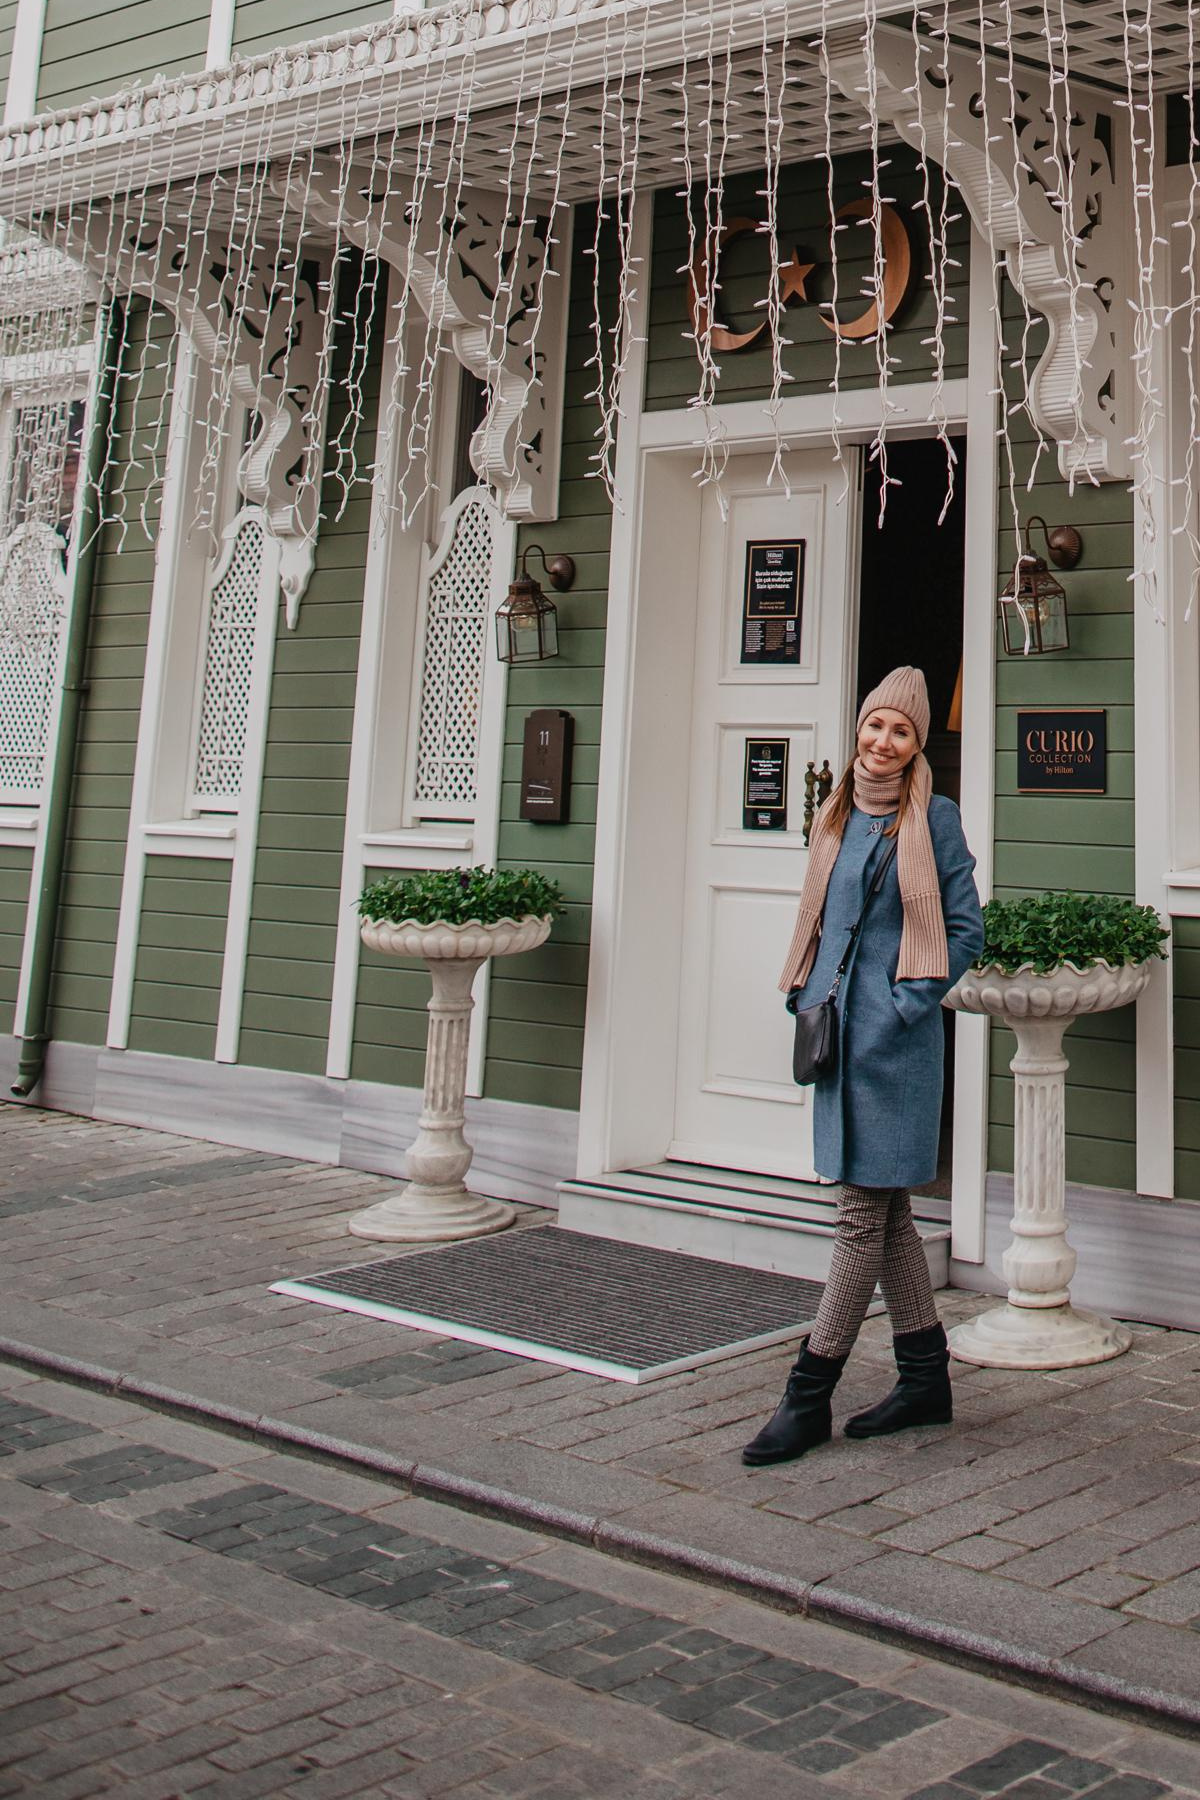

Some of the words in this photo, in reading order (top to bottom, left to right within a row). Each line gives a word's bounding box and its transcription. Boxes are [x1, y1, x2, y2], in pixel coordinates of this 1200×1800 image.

[539, 730, 549, 746] 11
[1026, 730, 1094, 752] CURIO
[1029, 754, 1091, 763] COLLECTION
[1046, 766, 1053, 775] by
[1054, 766, 1073, 774] Hilton
